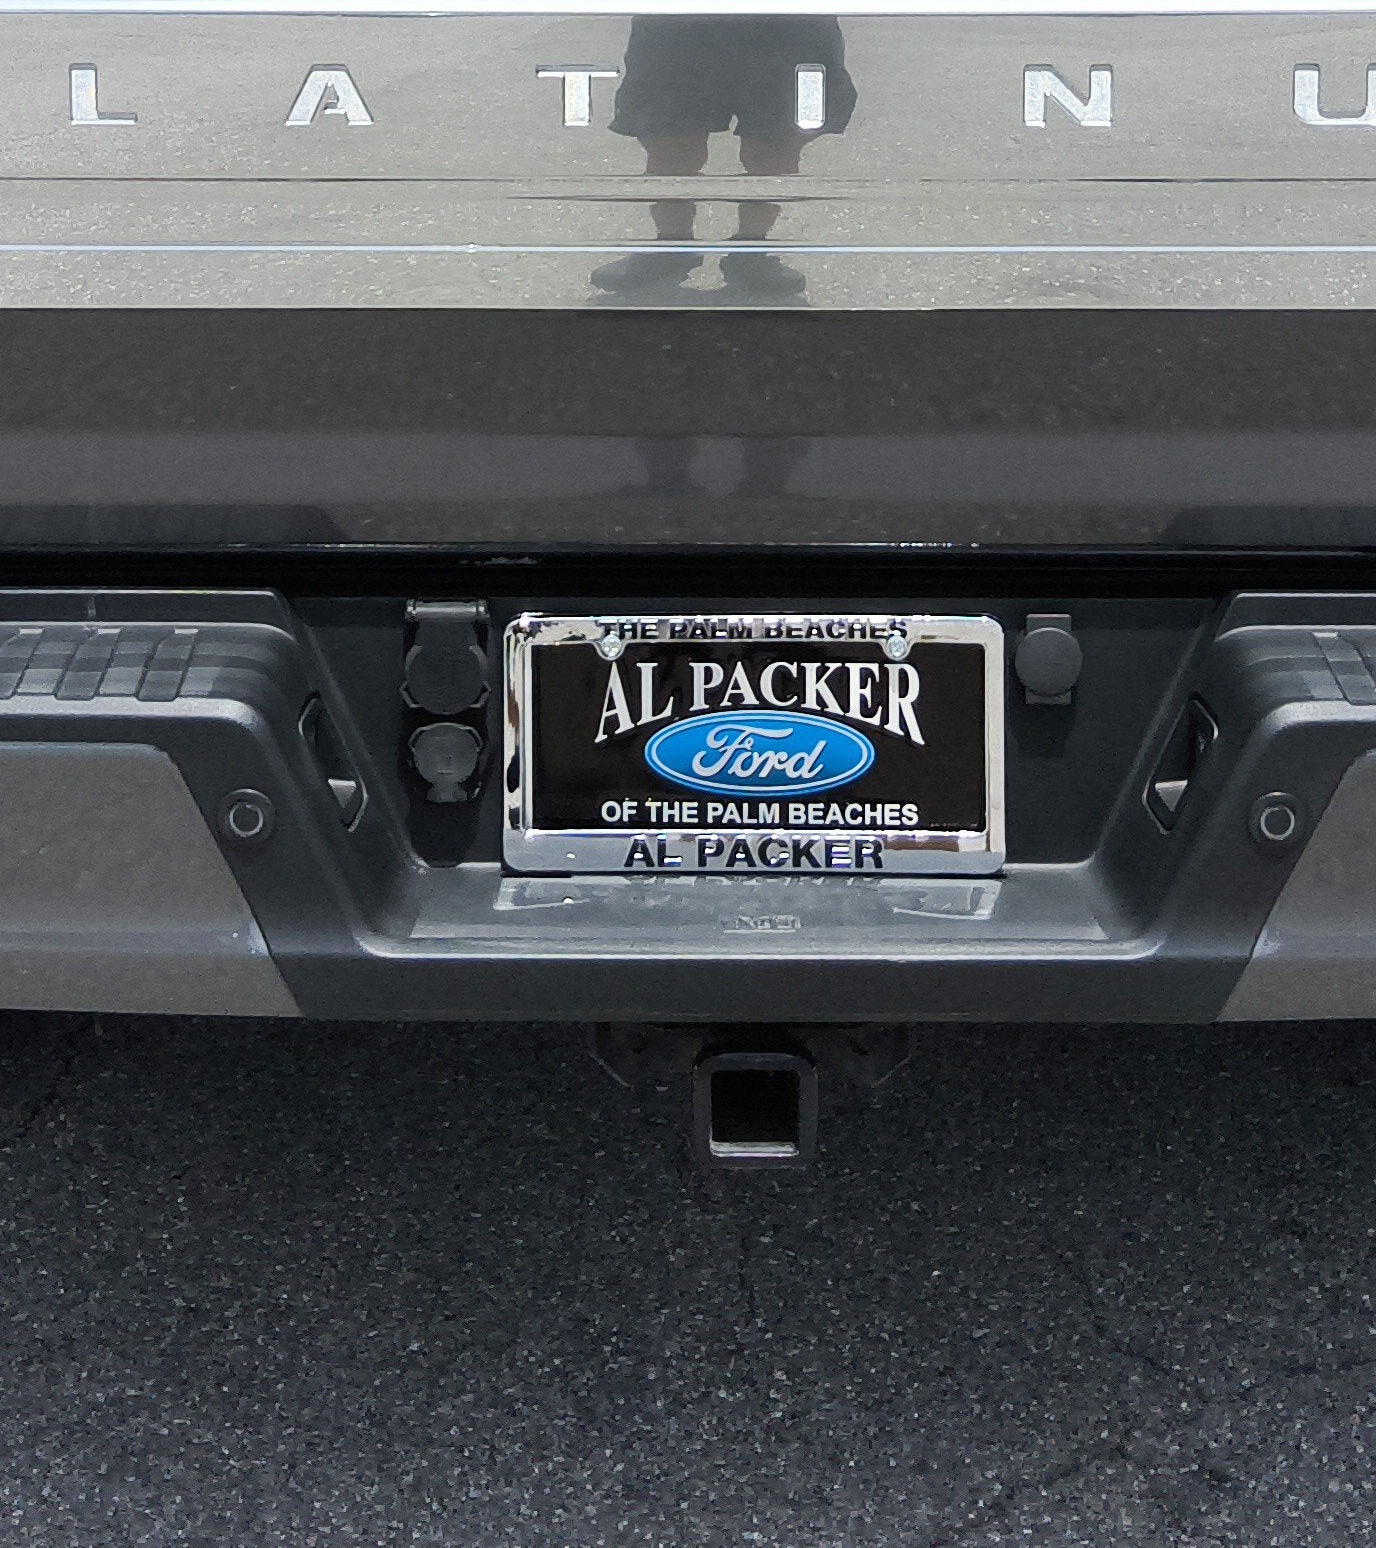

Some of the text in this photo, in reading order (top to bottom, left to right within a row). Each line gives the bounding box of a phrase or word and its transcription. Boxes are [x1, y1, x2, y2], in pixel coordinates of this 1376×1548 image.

[598, 617, 908, 640] THE PALM BEACHES
[594, 660, 926, 746] AL PACKER
[691, 724, 824, 780] Ford
[601, 799, 919, 826] OF THE PALM BEACHES
[624, 836, 884, 869] AL PACKER
